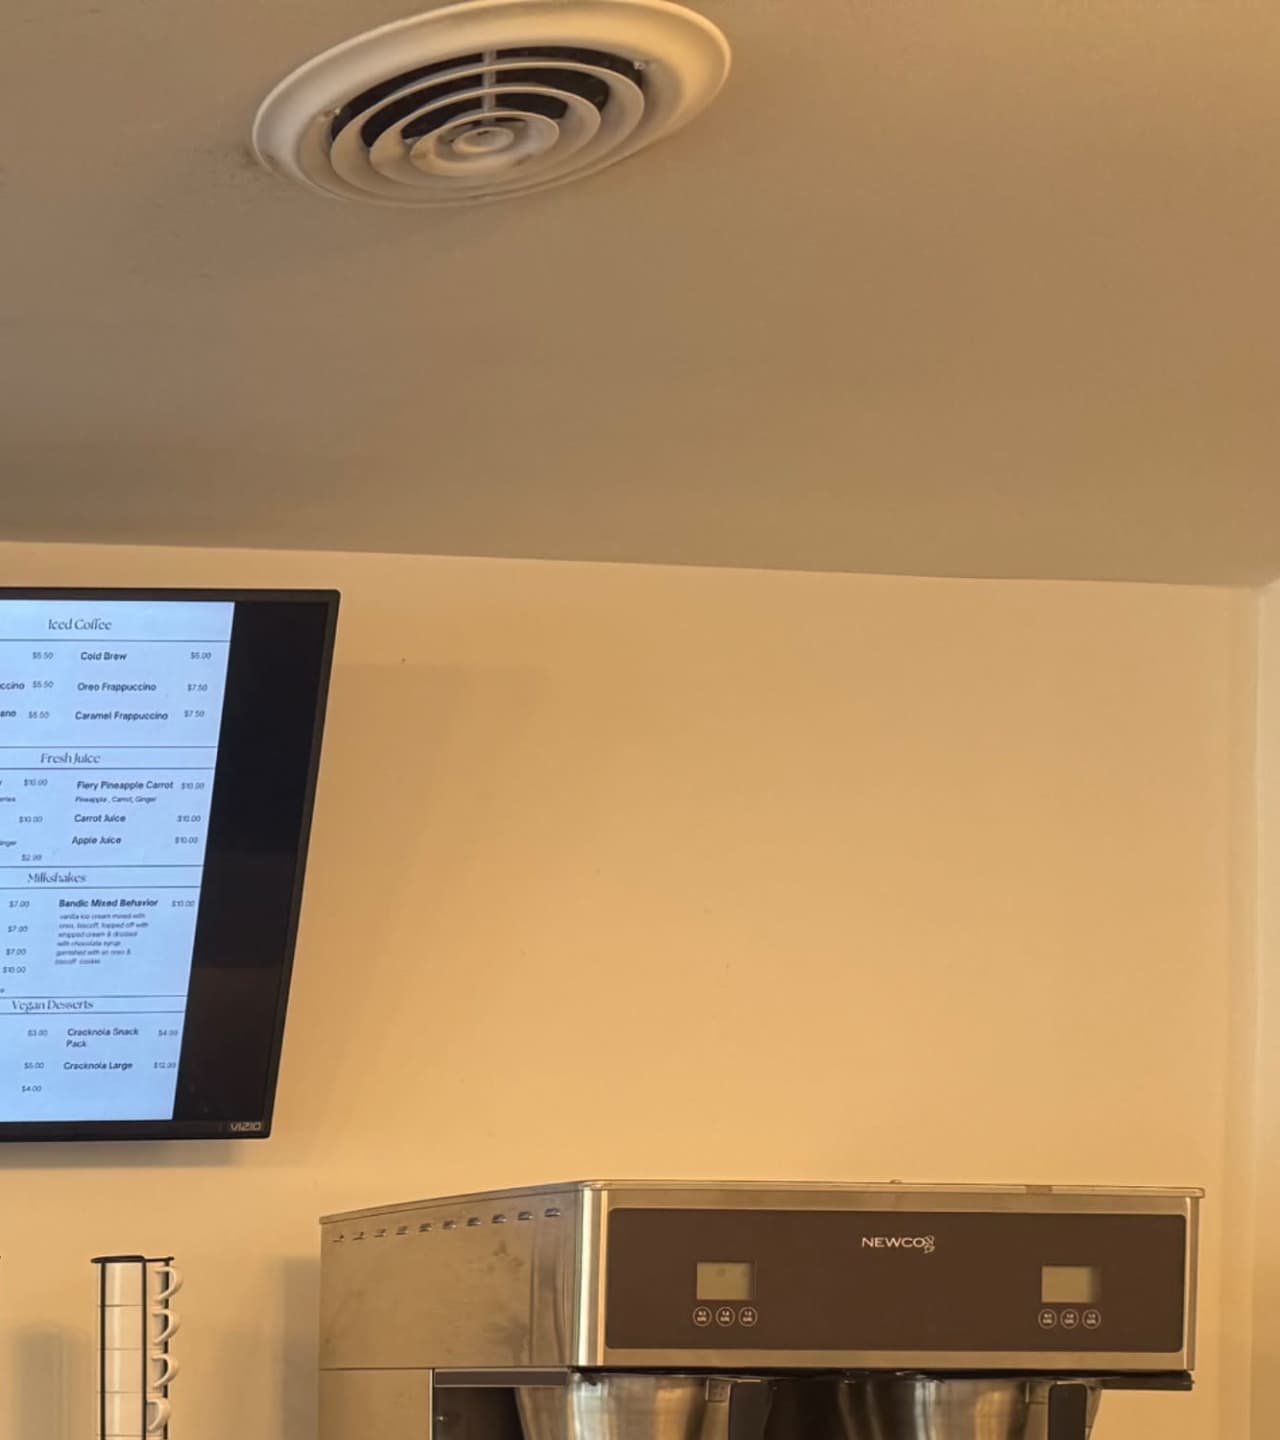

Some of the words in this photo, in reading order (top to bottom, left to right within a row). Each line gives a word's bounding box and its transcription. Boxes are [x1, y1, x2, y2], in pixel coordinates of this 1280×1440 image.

[48, 618, 73, 630] Iced
[74, 618, 112, 630] Coffee
[80, 651, 103, 661] Cold
[105, 651, 127, 661] Brew
[77, 681, 99, 692] Oreo
[102, 682, 157, 694] Frappuccino
[40, 752, 72, 764] Fresh
[72, 752, 101, 765] Juice
[27, 871, 87, 885] Milkshakes
[12, 999, 47, 1014] Vegan
[47, 998, 94, 1012] Desserts
[861, 1237, 926, 1248] NEWCO
